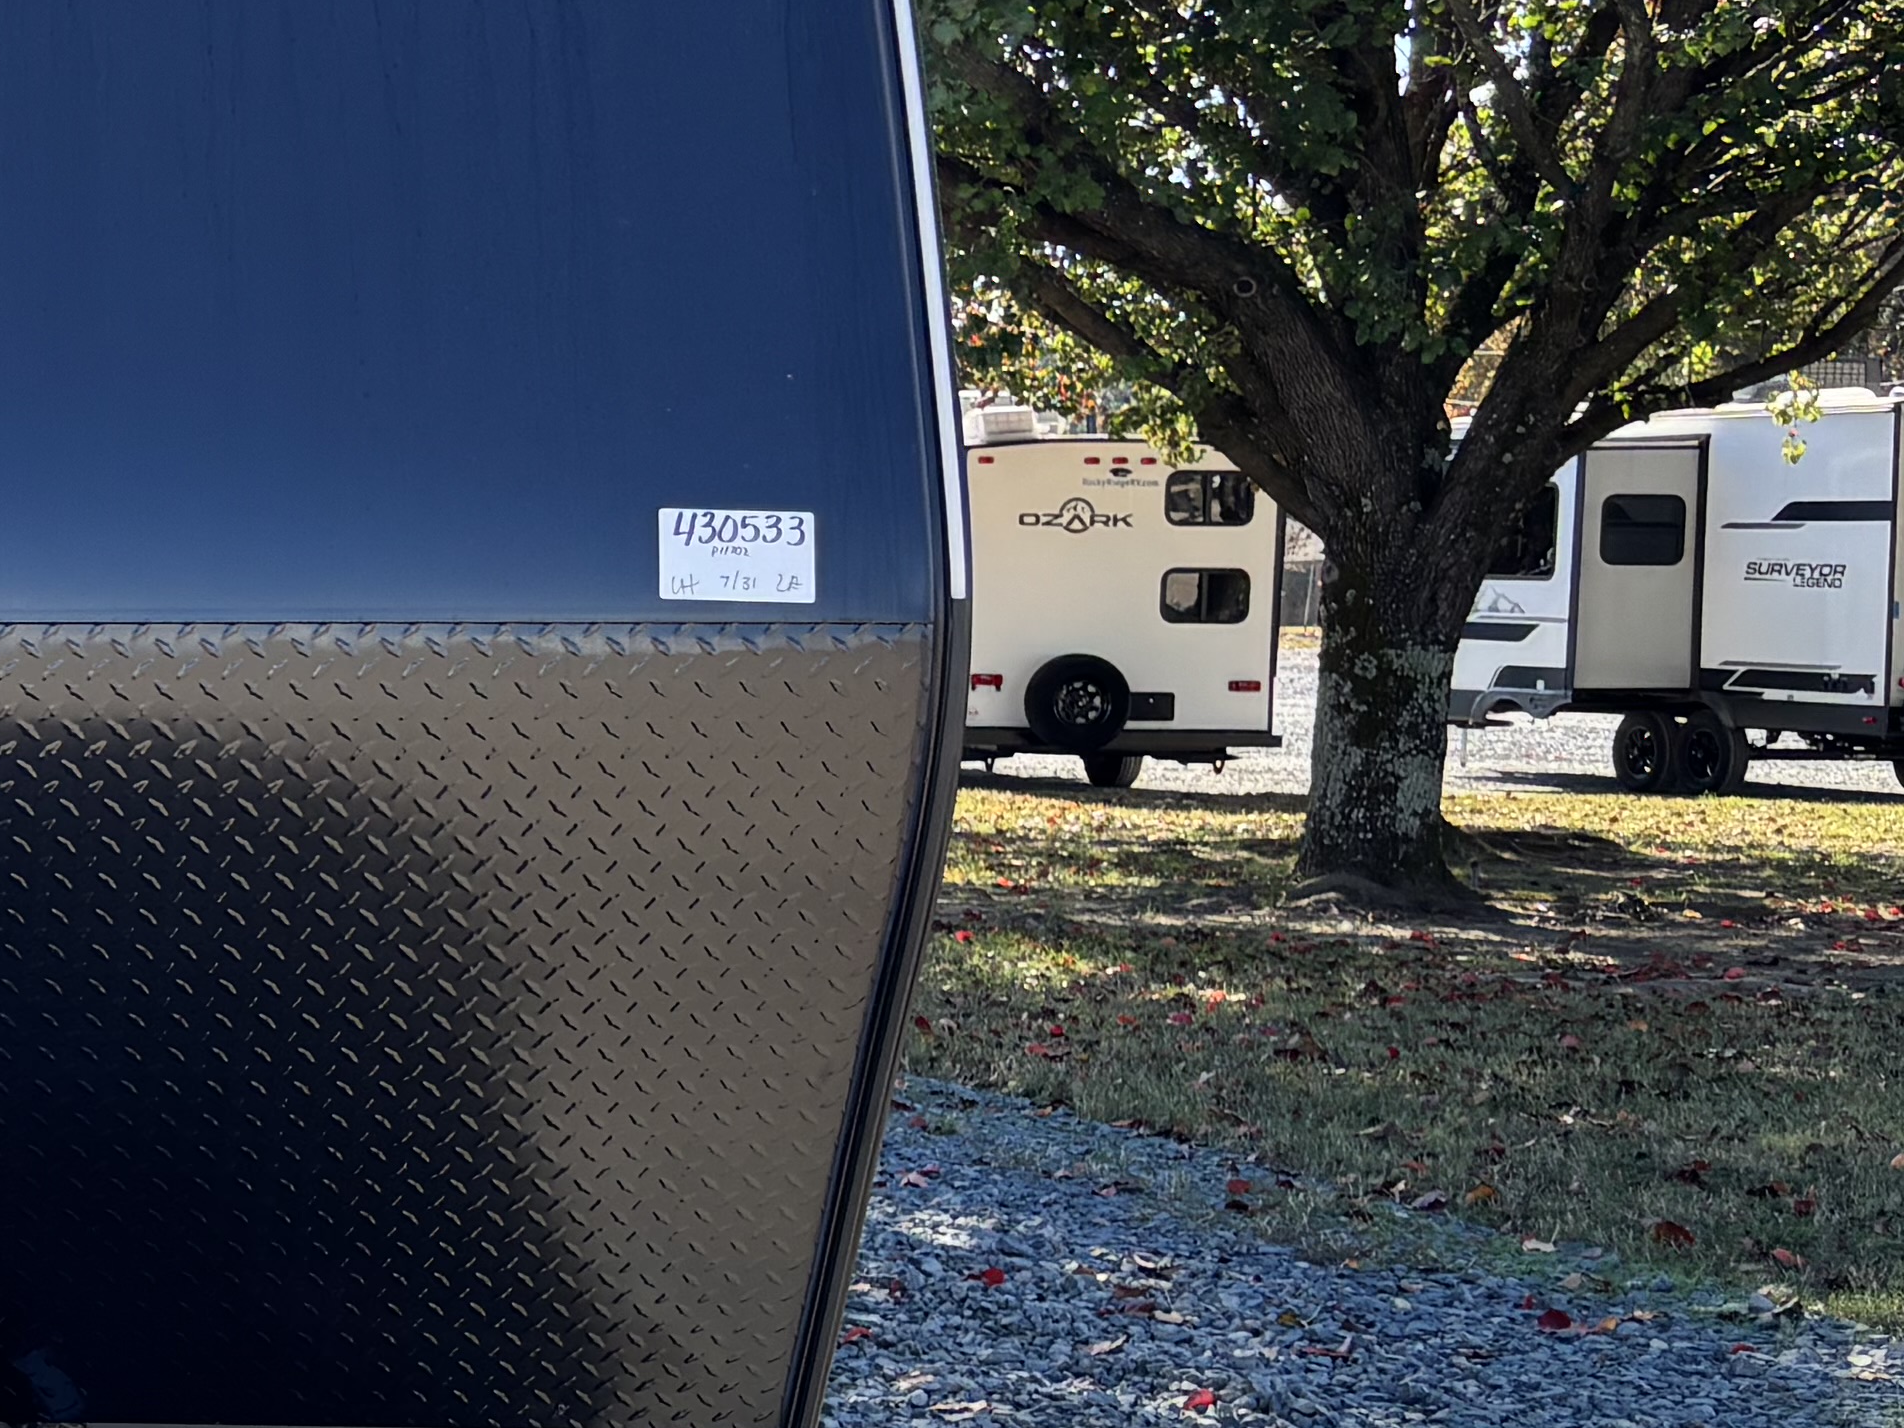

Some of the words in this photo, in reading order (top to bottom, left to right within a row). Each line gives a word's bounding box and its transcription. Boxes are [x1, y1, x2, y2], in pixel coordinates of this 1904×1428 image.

[672, 511, 806, 547] 430533
[1018, 508, 1134, 533] OZARK
[1745, 561, 1847, 577] SURVEYOR
[719, 570, 757, 590] 7/31
[1792, 574, 1843, 588] LEGEND
